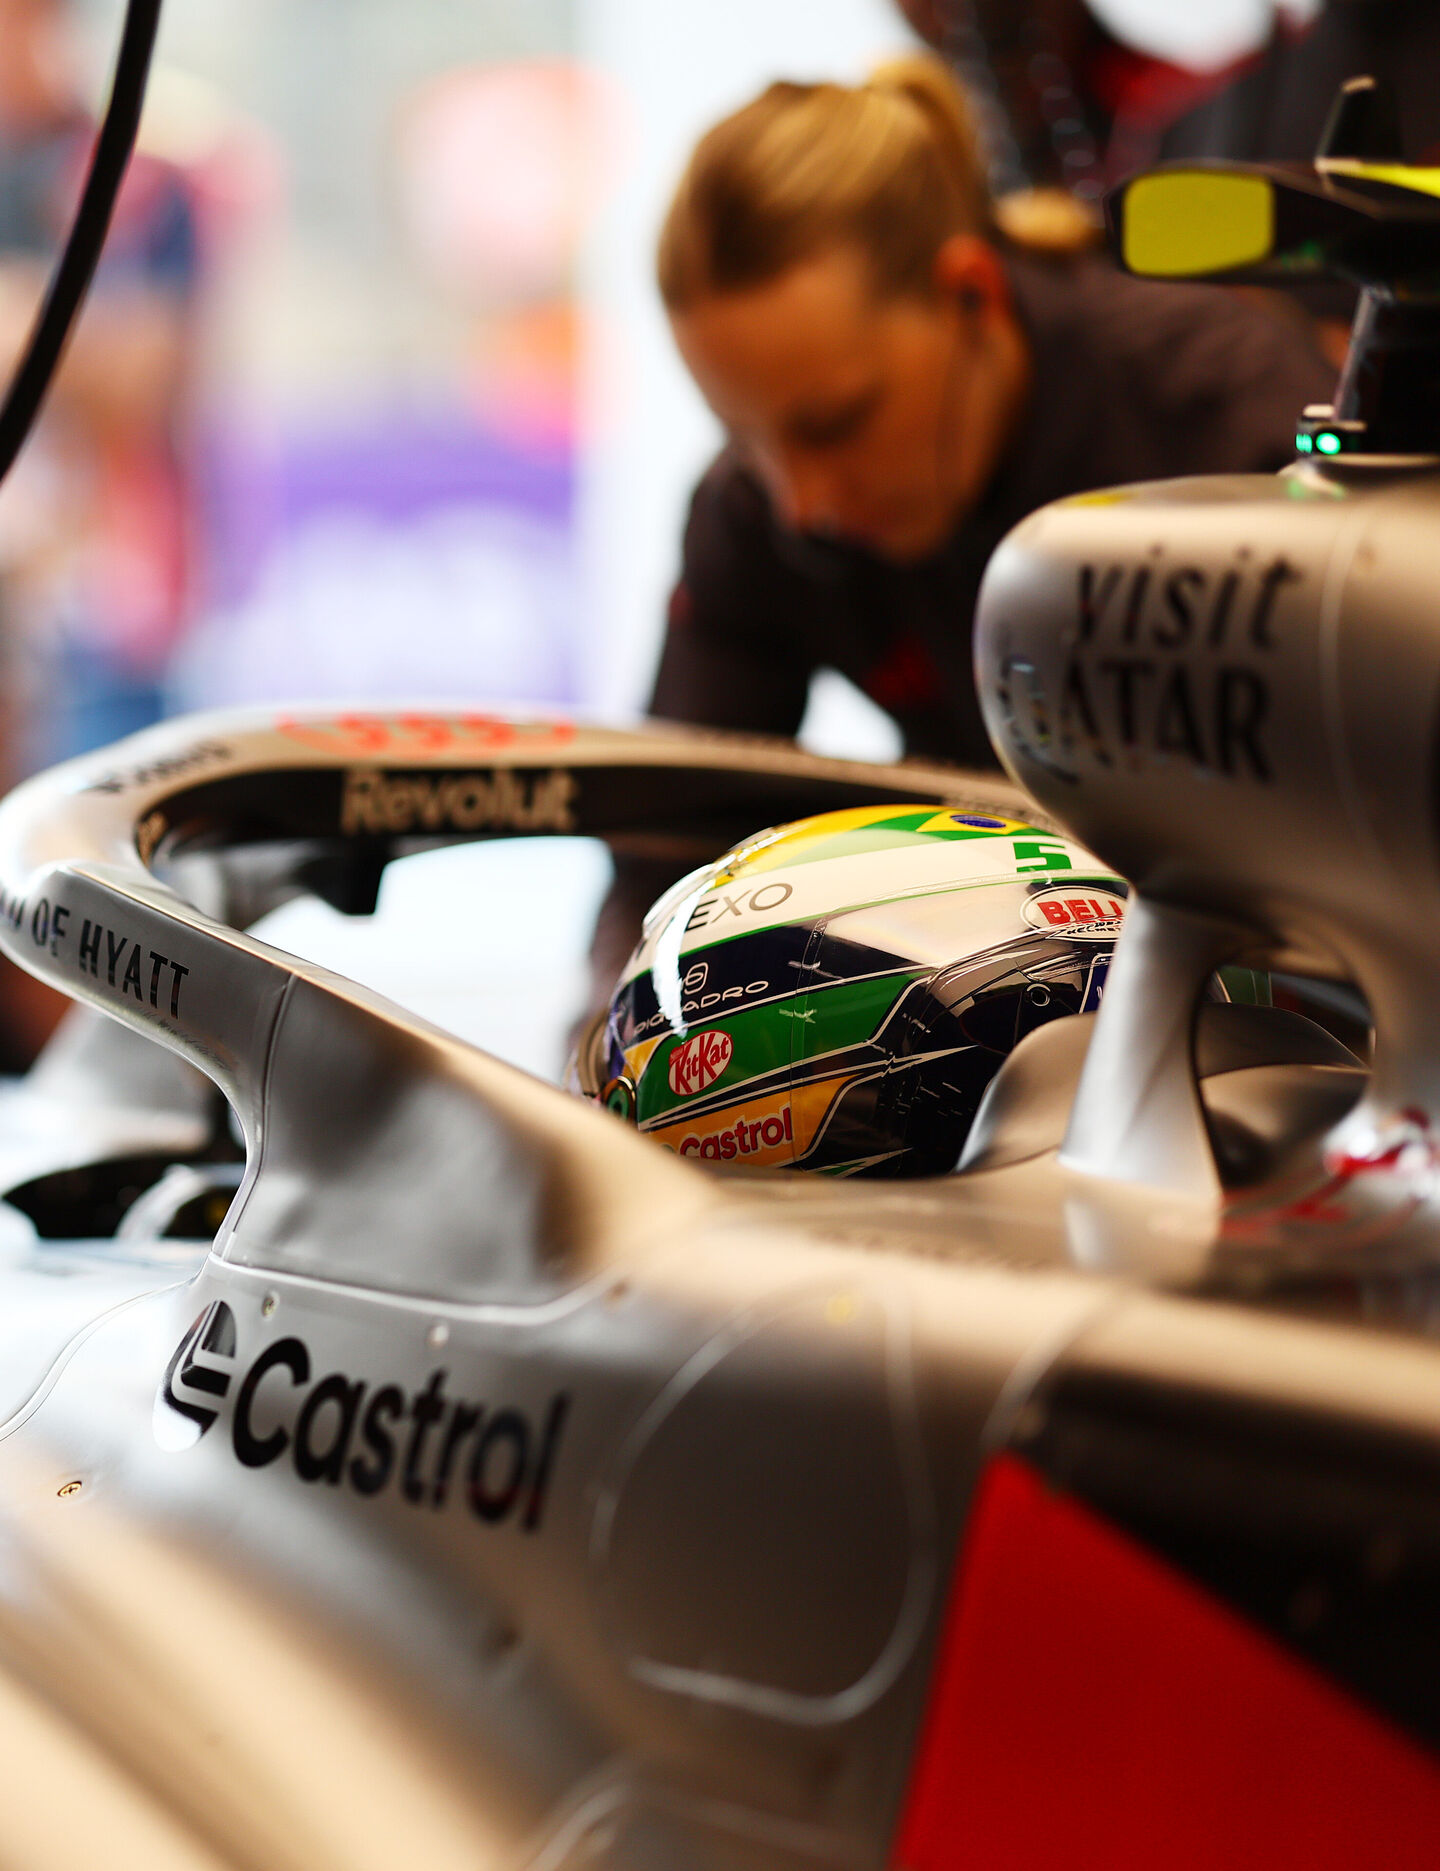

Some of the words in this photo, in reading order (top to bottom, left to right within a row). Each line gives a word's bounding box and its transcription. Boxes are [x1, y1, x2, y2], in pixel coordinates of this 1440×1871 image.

[1076, 545, 1303, 651] visit
[341, 767, 579, 832] Revolut
[1013, 842, 1072, 872] 5
[660, 882, 793, 936] EXO
[32, 898, 70, 957] OF
[79, 919, 189, 1020] HYATT
[674, 1032, 729, 1093] KitKat
[679, 1106, 793, 1161] Castrol
[233, 1337, 570, 1533] Castrol
